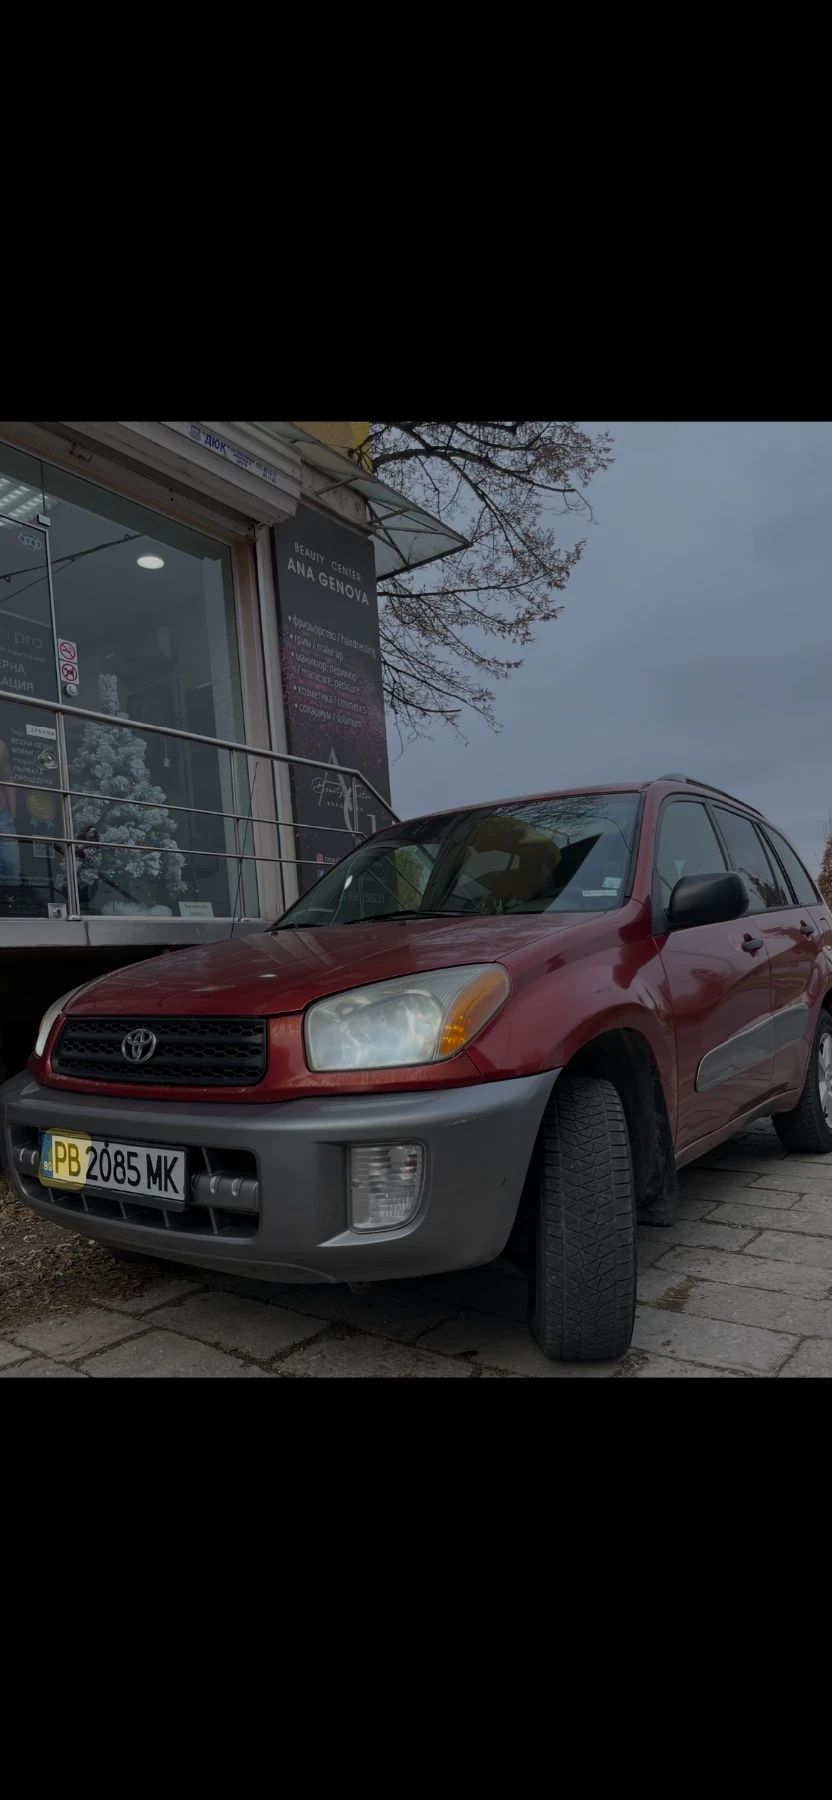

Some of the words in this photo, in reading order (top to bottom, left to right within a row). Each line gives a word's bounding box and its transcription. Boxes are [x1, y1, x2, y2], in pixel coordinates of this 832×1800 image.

[294, 542, 325, 565] BEAUTY
[331, 561, 362, 583] CENTER
[287, 557, 315, 582] ANA
[318, 572, 370, 607] GENOVA
[293, 633, 312, 650] грим
[316, 641, 335, 657] make
[335, 649, 344, 662] up
[341, 633, 377, 660] hairdressing
[0, 675, 34, 693] АЦИЯ
[334, 675, 360, 696] pedicure
[298, 686, 333, 704] козметика
[337, 696, 367, 715] cosmetics
[13, 765, 44, 776] ПЪРВАТА
[14, 774, 54, 786] ПРОЦЕДУРА
[54, 1140, 81, 1177] PB
[85, 1146, 141, 1187] 2085
[146, 1153, 179, 1194] MK
